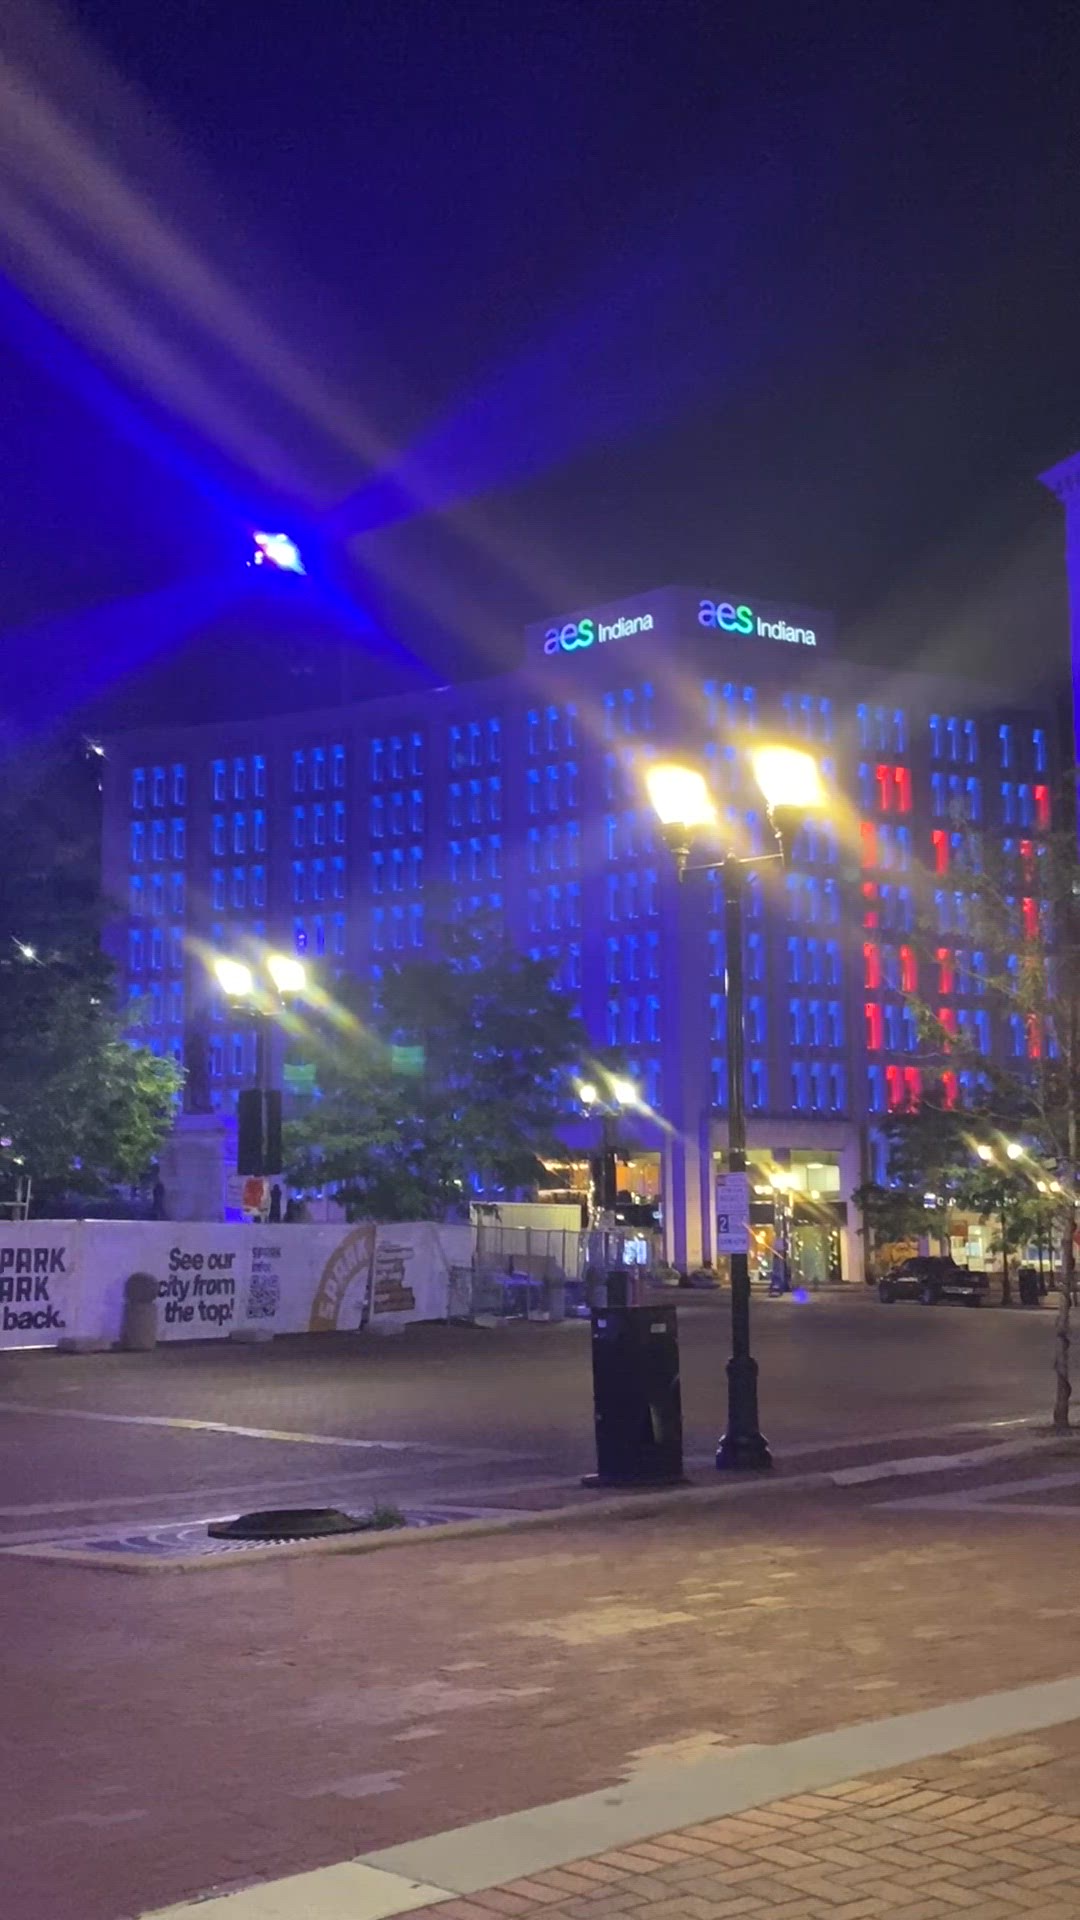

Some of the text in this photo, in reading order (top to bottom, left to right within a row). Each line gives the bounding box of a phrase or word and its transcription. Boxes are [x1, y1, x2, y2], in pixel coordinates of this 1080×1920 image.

[543, 613, 654, 655] aes Indiana
[698, 599, 817, 647] aes Indiana
[719, 1216, 728, 1232] 2
[0, 1247, 66, 1273] PARK
[168, 1247, 237, 1271] See our
[157, 1274, 235, 1303] city from
[3, 1304, 66, 1331] back.
[165, 1298, 235, 1327] the top!
